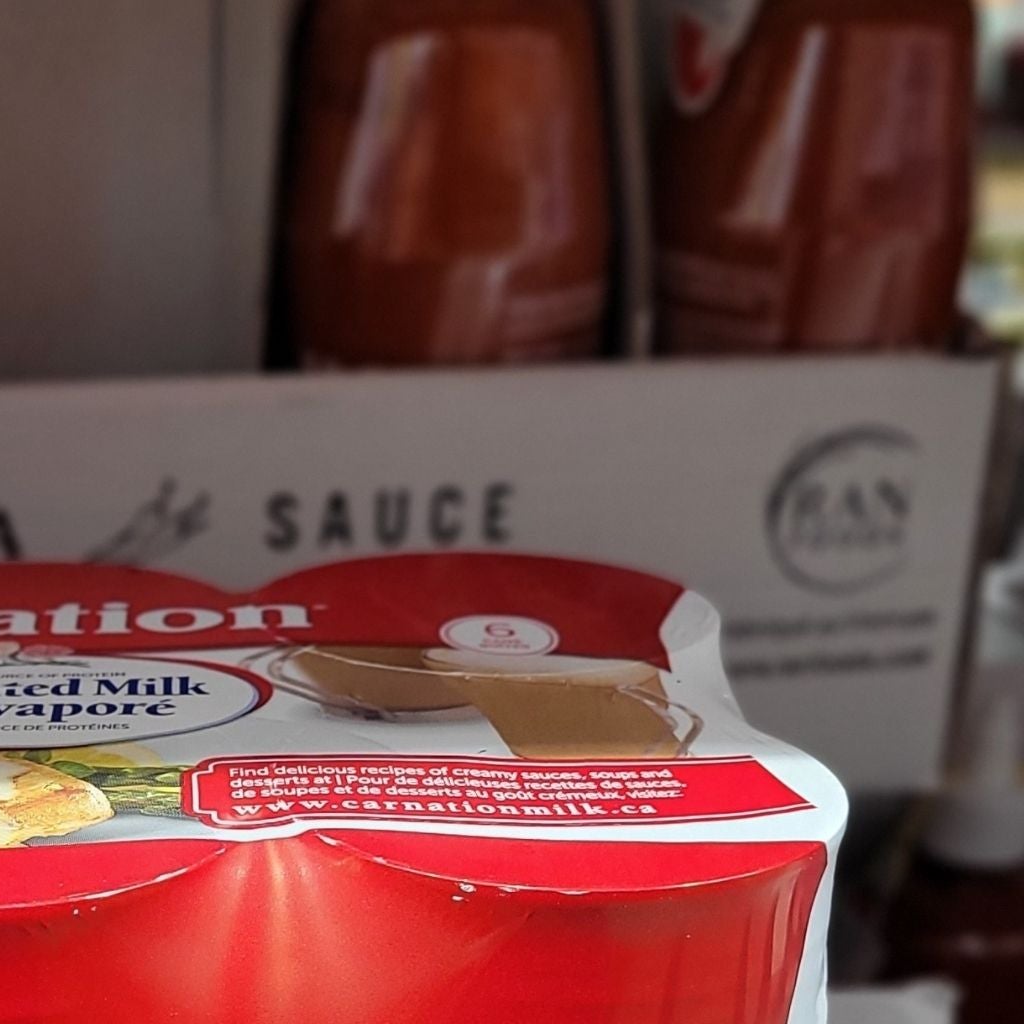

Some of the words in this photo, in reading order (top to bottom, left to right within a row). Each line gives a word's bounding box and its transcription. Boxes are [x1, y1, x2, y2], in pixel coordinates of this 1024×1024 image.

[263, 482, 515, 553] SAUCE
[485, 622, 515, 638] 6
[92, 675, 211, 697] Milk
[24, 724, 45, 732] DE
[47, 722, 130, 732] PROTÉINES
[229, 766, 269, 778] Find
[274, 764, 357, 776] delicious
[359, 765, 426, 777] recipes
[429, 766, 448, 775] of
[452, 767, 518, 781] creamy
[589, 770, 640, 780] soups
[640, 768, 674, 779] and
[230, 777, 310, 788] desserts
[313, 775, 333, 785] at
[346, 774, 390, 785] Pour
[394, 775, 418, 785] de
[422, 776, 522, 790] délicieuses
[523, 780, 598, 791] recettes
[599, 779, 624, 789] de
[231, 788, 257, 799] de
[260, 786, 330, 797] soupes
[333, 785, 354, 795] et
[356, 785, 381, 795] de
[385, 786, 463, 797] desserts
[465, 788, 489, 799] au
[492, 789, 536, 801] goût
[231, 799, 658, 817] www.carnationmilk.ca
